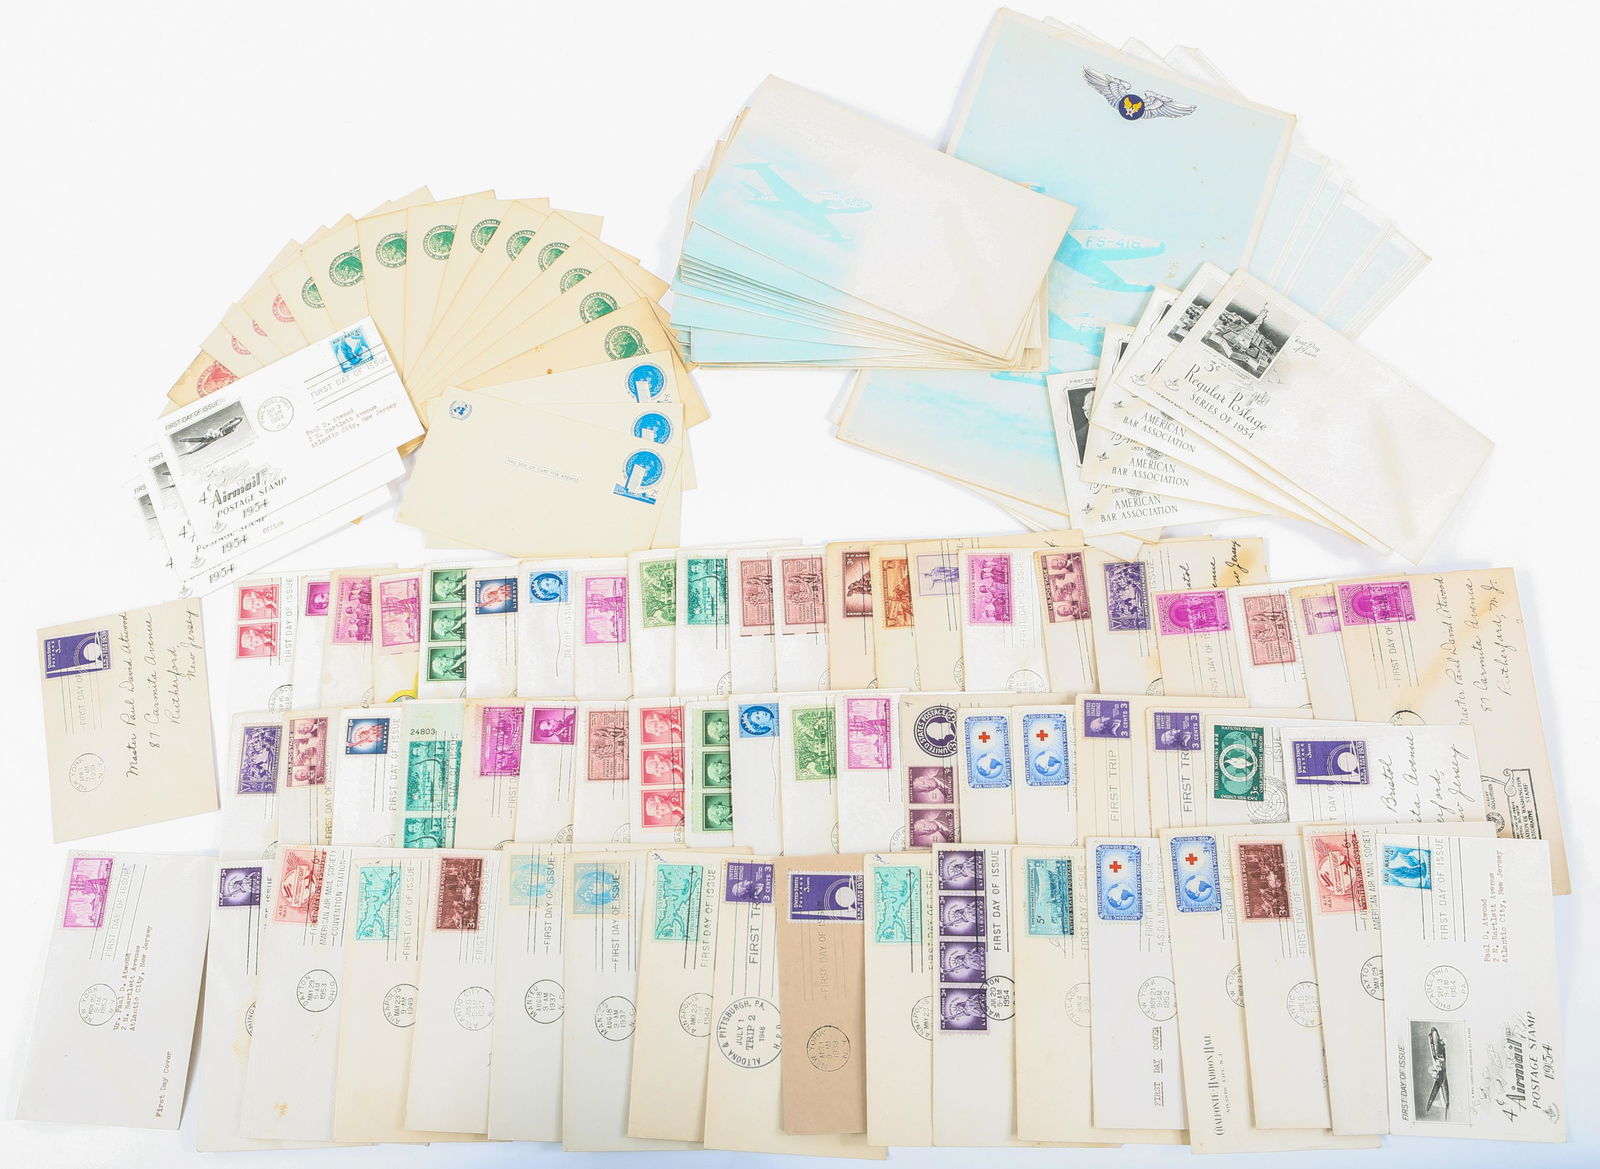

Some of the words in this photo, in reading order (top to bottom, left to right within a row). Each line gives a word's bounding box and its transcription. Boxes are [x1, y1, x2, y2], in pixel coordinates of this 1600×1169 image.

[311, 384, 332, 398] FIRST
[336, 375, 351, 386] DAY
[367, 356, 388, 370] ISSUE
[1184, 364, 1226, 403] Regular
[1228, 392, 1268, 431] Postage
[1141, 412, 1187, 437] AMERICAN
[1190, 393, 1218, 414] SERIES
[1220, 412, 1232, 424] OF
[1232, 422, 1256, 440] 1954
[1123, 416, 1139, 428] BAR
[1141, 424, 1197, 453] ASSOCIATION
[1112, 467, 1128, 476] BAR
[1132, 469, 1189, 487] ASSOCIATION
[1129, 457, 1177, 473] AMERICAN
[210, 472, 261, 508] Airmail
[217, 492, 255, 518] POSTAGE
[259, 476, 287, 495] STAMP
[1114, 495, 1161, 510] AMERICAN
[243, 499, 268, 518] 1954
[1101, 512, 1117, 522] BAR
[1121, 505, 1178, 520] ASSOCIATION
[222, 535, 248, 554] 1954
[209, 563, 236, 584] 1954
[286, 578, 294, 604] ISSUE
[119, 612, 131, 654] Atwood
[179, 608, 202, 649] Jersey
[1385, 626, 1394, 635] OF
[1440, 622, 1458, 655] David
[285, 642, 293, 663] FIRST
[1387, 639, 1396, 654] DAY
[119, 658, 136, 692] David
[187, 653, 196, 680] New
[1391, 659, 1400, 681] FIRST
[1445, 658, 1463, 685] Paul
[120, 698, 136, 726] Paul
[921, 709, 947, 722] POSTAGE
[392, 719, 400, 747] ISSUE
[917, 723, 928, 742] STATES
[126, 734, 139, 778] Master
[924, 743, 949, 754] UNITED
[1273, 736, 1281, 763] ISSUE
[1402, 730, 1419, 786] Avenue
[1108, 749, 1118, 781] TRIP
[1448, 744, 1475, 802] Jersey
[1183, 776, 1192, 812] FIRST
[1381, 754, 1397, 813] Bristol
[389, 786, 397, 810] FIRST
[1110, 786, 1120, 822] FIRST
[1328, 794, 1337, 812] DAY
[1362, 830, 1371, 856] SOCIETY
[1435, 838, 1444, 865] ISSUE
[547, 857, 555, 886] ISSUE
[991, 851, 1000, 879] ISSUE
[1240, 846, 1248, 873] POSTAGE
[407, 866, 415, 888] ISSUE
[612, 874, 621, 898] ISSUE
[706, 869, 716, 896] ISSUE
[1291, 859, 1301, 888] ISSUE
[1437, 871, 1446, 884] OF
[319, 911, 329, 945] AMERICAN
[328, 850, 337, 876] SOCIETY
[546, 887, 555, 899] OF
[992, 883, 1001, 899] OF
[1439, 889, 1448, 906] DAY
[105, 934, 116, 957] FIRST
[112, 914, 121, 929] DAY
[120, 867, 132, 896] ISSUE
[332, 891, 342, 936] CONVENTION
[404, 909, 413, 926] DAY
[544, 902, 553, 919] DAY
[612, 905, 621, 916] OF
[705, 902, 713, 916] OF
[994, 903, 1002, 923] DAY
[1296, 907, 1304, 923] DAY
[543, 920, 552, 945] FIRST
[612, 919, 621, 935] DAY
[703, 919, 712, 938] DAY
[994, 926, 1002, 951] FIRST
[1298, 926, 1307, 954] FIRST
[1483, 931, 1489, 940] D.
[403, 931, 411, 956] FIRST
[611, 938, 620, 963] FIRST
[701, 939, 710, 968] FIRST
[749, 926, 759, 964] FIRST
[819, 944, 829, 962] DAY
[1483, 944, 1491, 962] Paul
[116, 994, 124, 1013] Paul
[122, 953, 131, 979] Atwood
[130, 996, 140, 1031] Atlantic
[143, 925, 153, 952] Jersey
[299, 975, 311, 1007] DAYTON
[820, 968, 829, 993] FIRST
[1362, 961, 1376, 996] DAYTON
[1427, 968, 1450, 1010] PHILADELPHIA
[125, 975, 135, 1009] Bartlett
[746, 1023, 755, 1050] TRIP
[1527, 1011, 1537, 1050] STAMP
[163, 1051, 171, 1073] Cover
[728, 1049, 761, 1065] ALTOONA
[1542, 1042, 1555, 1080] 1954
[160, 1077, 168, 1090] Day
[1505, 1038, 1527, 1110] Airmail
[1529, 1058, 1542, 1109] POSTAGE
[1400, 1081, 1408, 1096] DAY
[156, 1094, 165, 1117] First
[1401, 1097, 1409, 1121] FIRST
